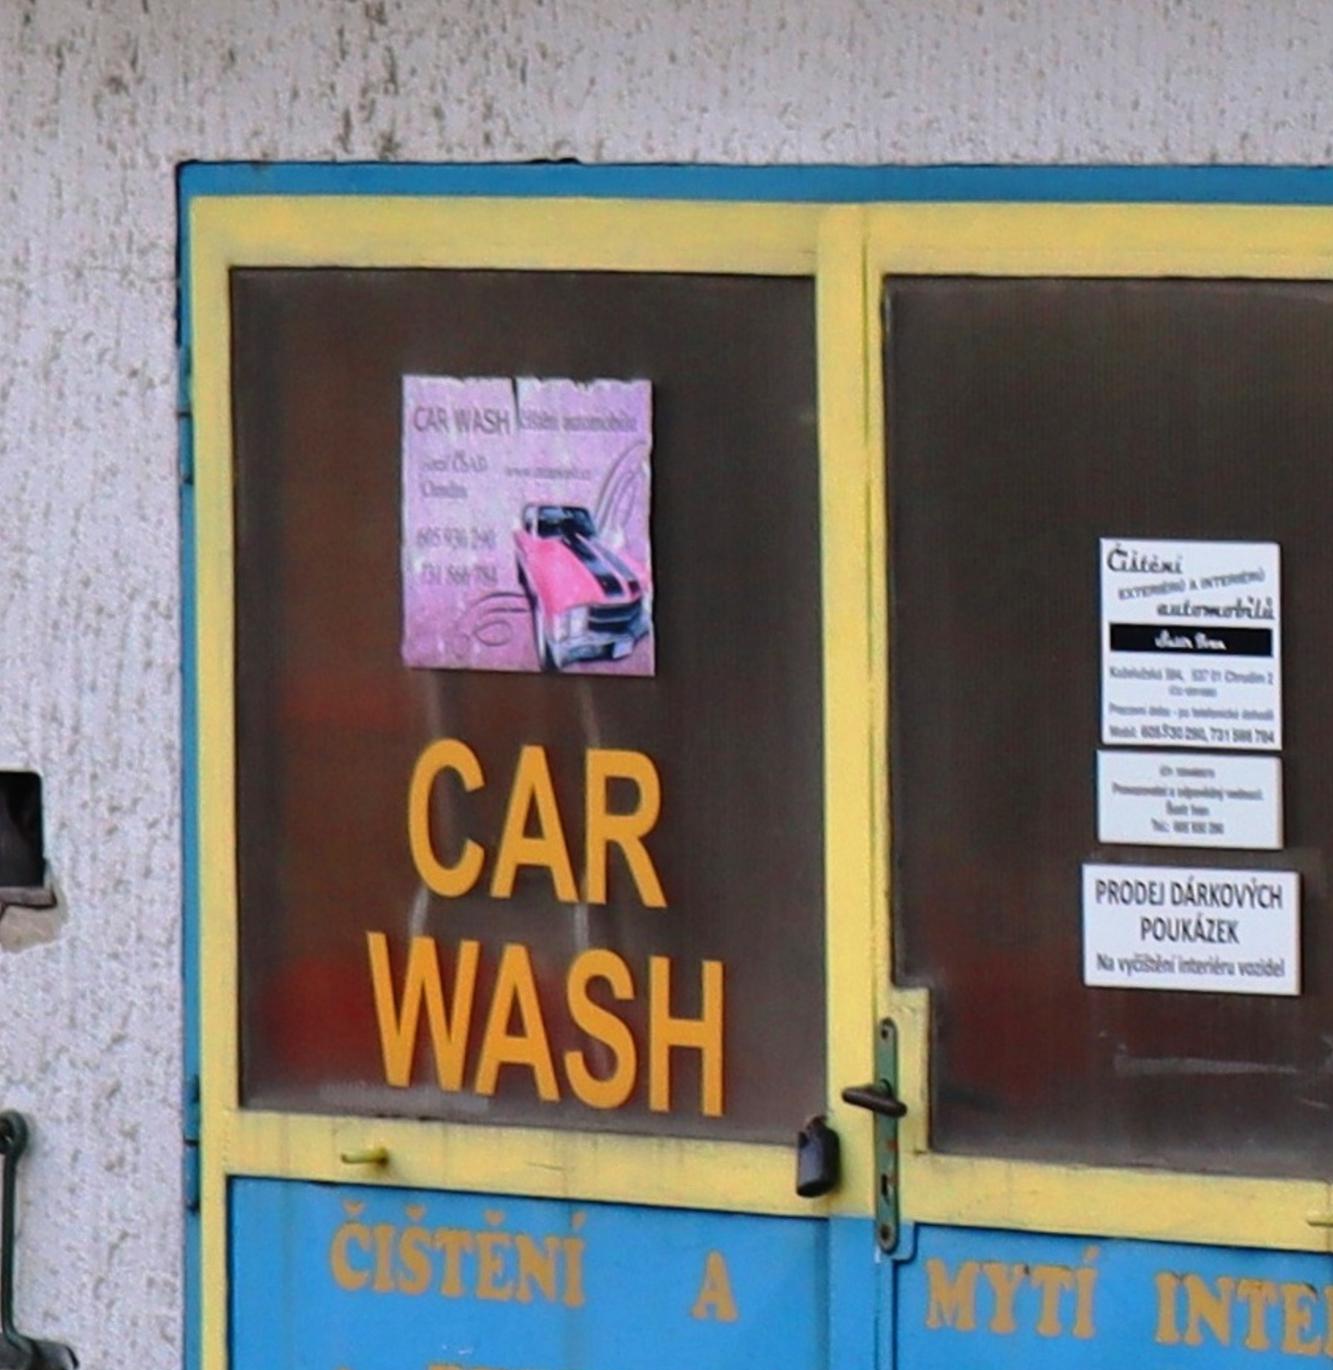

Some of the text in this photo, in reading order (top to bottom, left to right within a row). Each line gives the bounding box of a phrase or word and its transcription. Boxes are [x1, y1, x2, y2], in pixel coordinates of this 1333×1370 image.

[413, 406, 448, 434] CAR
[454, 407, 510, 435] WASH
[1189, 580, 1201, 592] A
[408, 738, 667, 908] CAR
[1095, 874, 1283, 909] PRODEJ DÁRKOVÝCH
[1140, 913, 1240, 945] POUKÁZEK
[1097, 953, 1115, 972] Na
[1238, 957, 1285, 978] vozidel
[366, 931, 723, 1117] WASH
[330, 1199, 738, 1322] ČIŠTĚNÍ A
[925, 1246, 1098, 1339] MYTÍ
